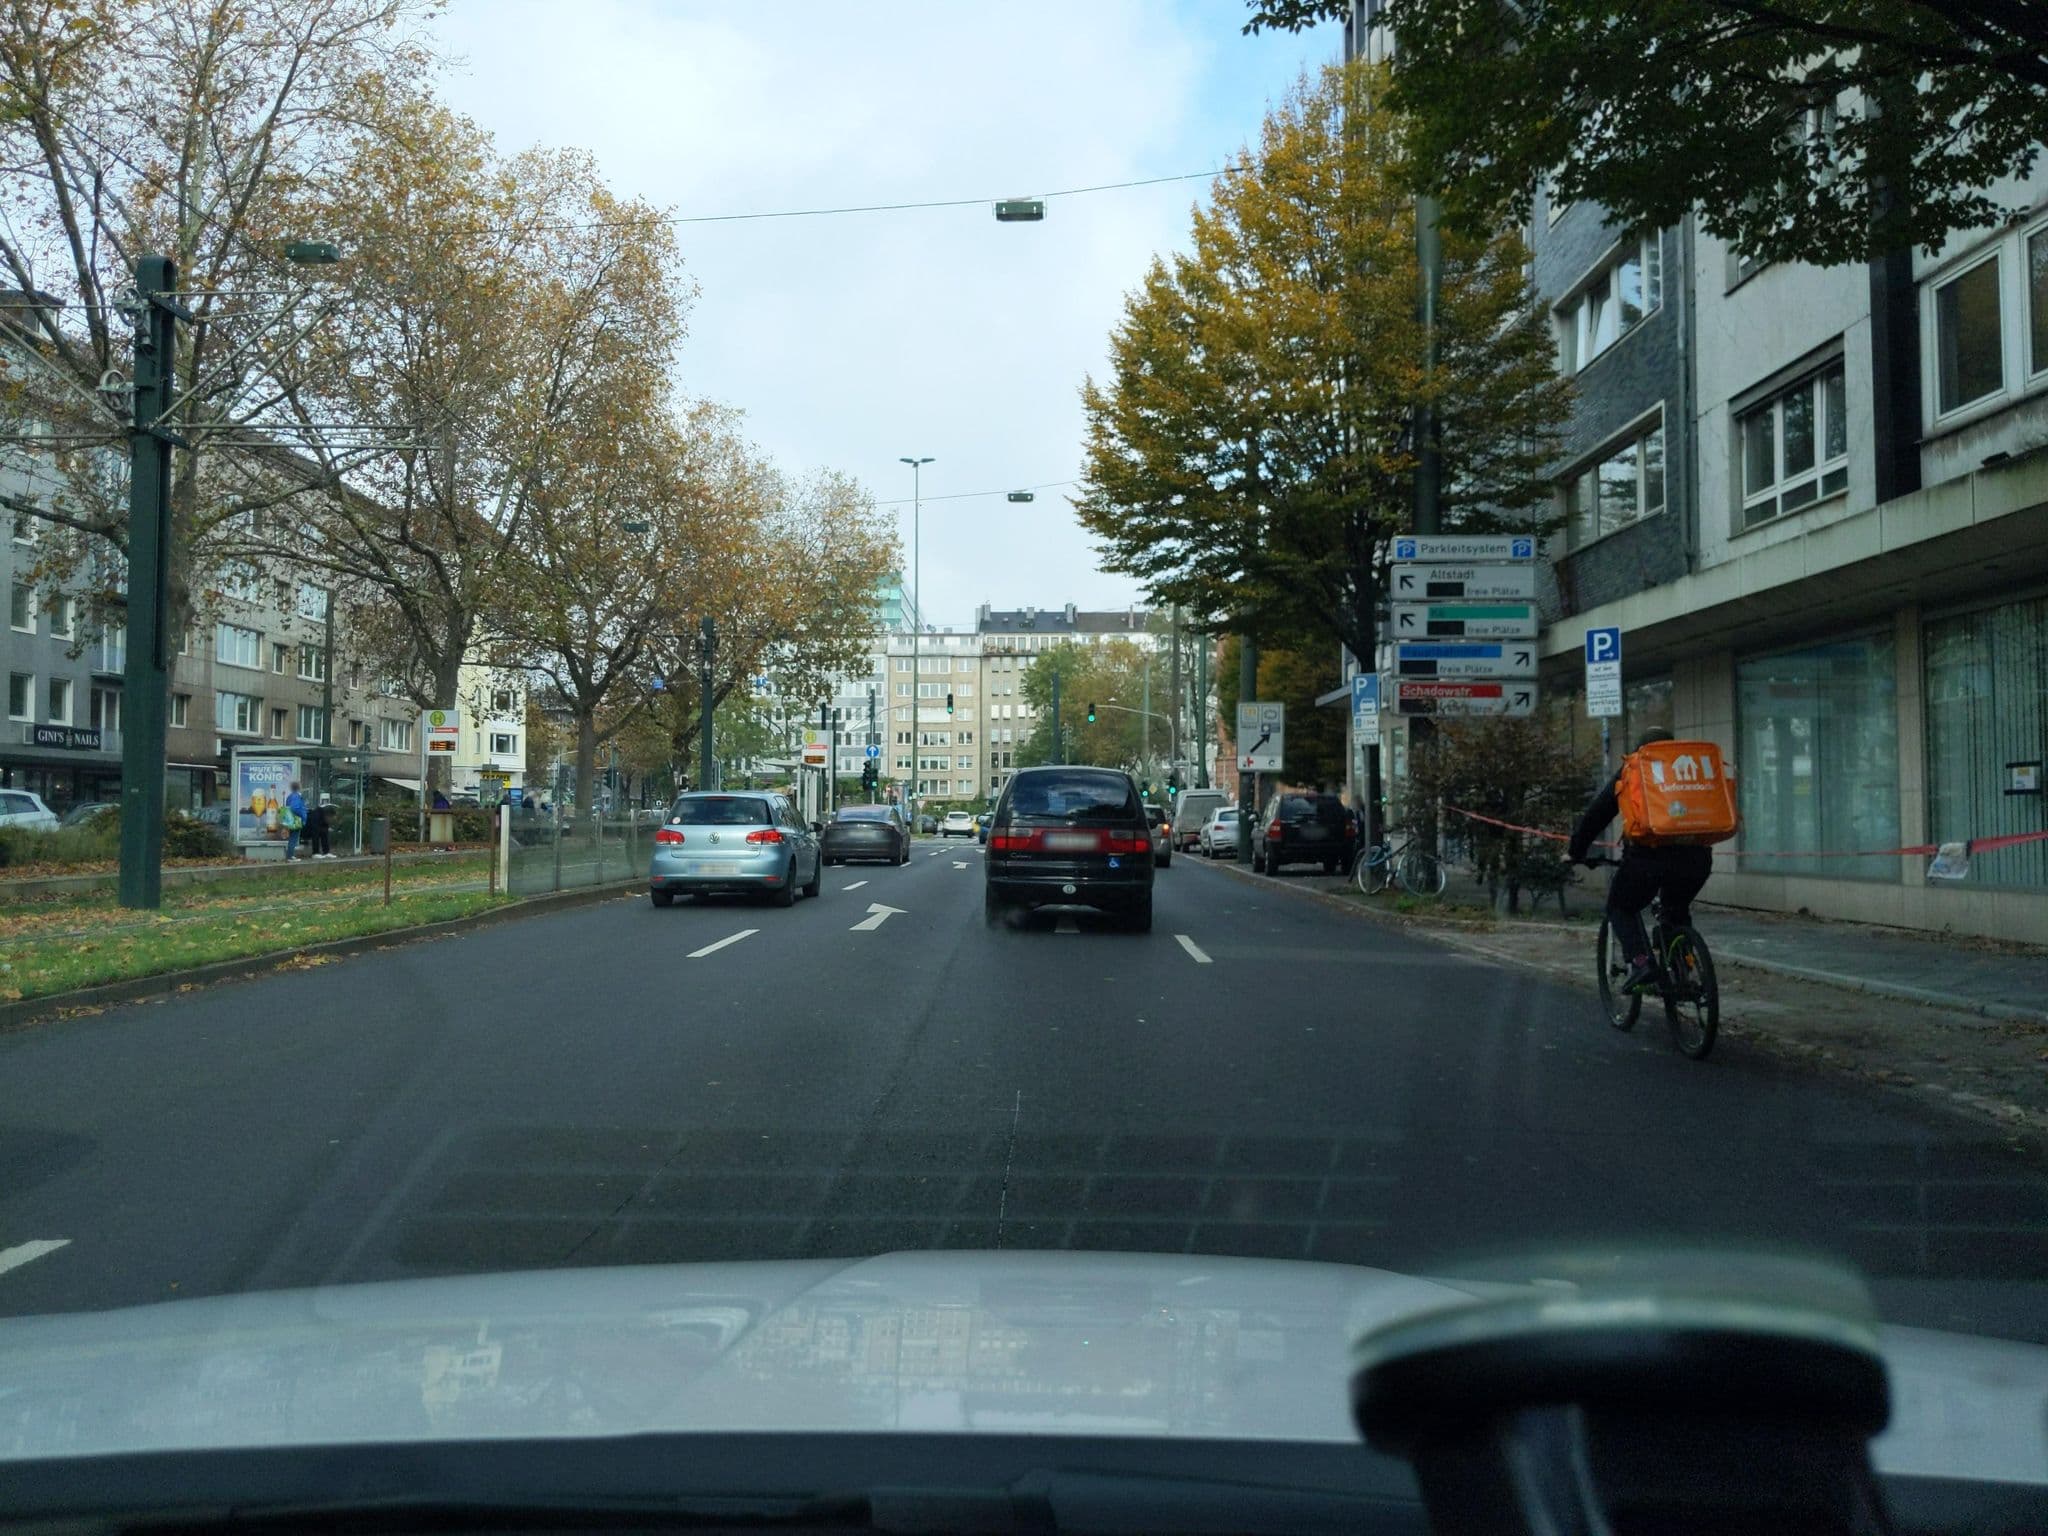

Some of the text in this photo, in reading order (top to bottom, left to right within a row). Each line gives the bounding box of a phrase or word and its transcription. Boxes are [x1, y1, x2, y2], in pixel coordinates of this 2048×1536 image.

[1421, 543, 1508, 555] Parkleitsystem
[1430, 569, 1475, 580] Altstadt
[1467, 587, 1521, 596] freie Plätze
[1467, 625, 1521, 634] freie Plätze
[1593, 632, 1612, 661] P
[1439, 664, 1494, 673] freie Plätze
[1355, 677, 1368, 696] P
[1402, 684, 1473, 697] Schadowstr.
[37, 729, 99, 746] GINI'S NAILS
[248, 772, 284, 781] KÖNIG
